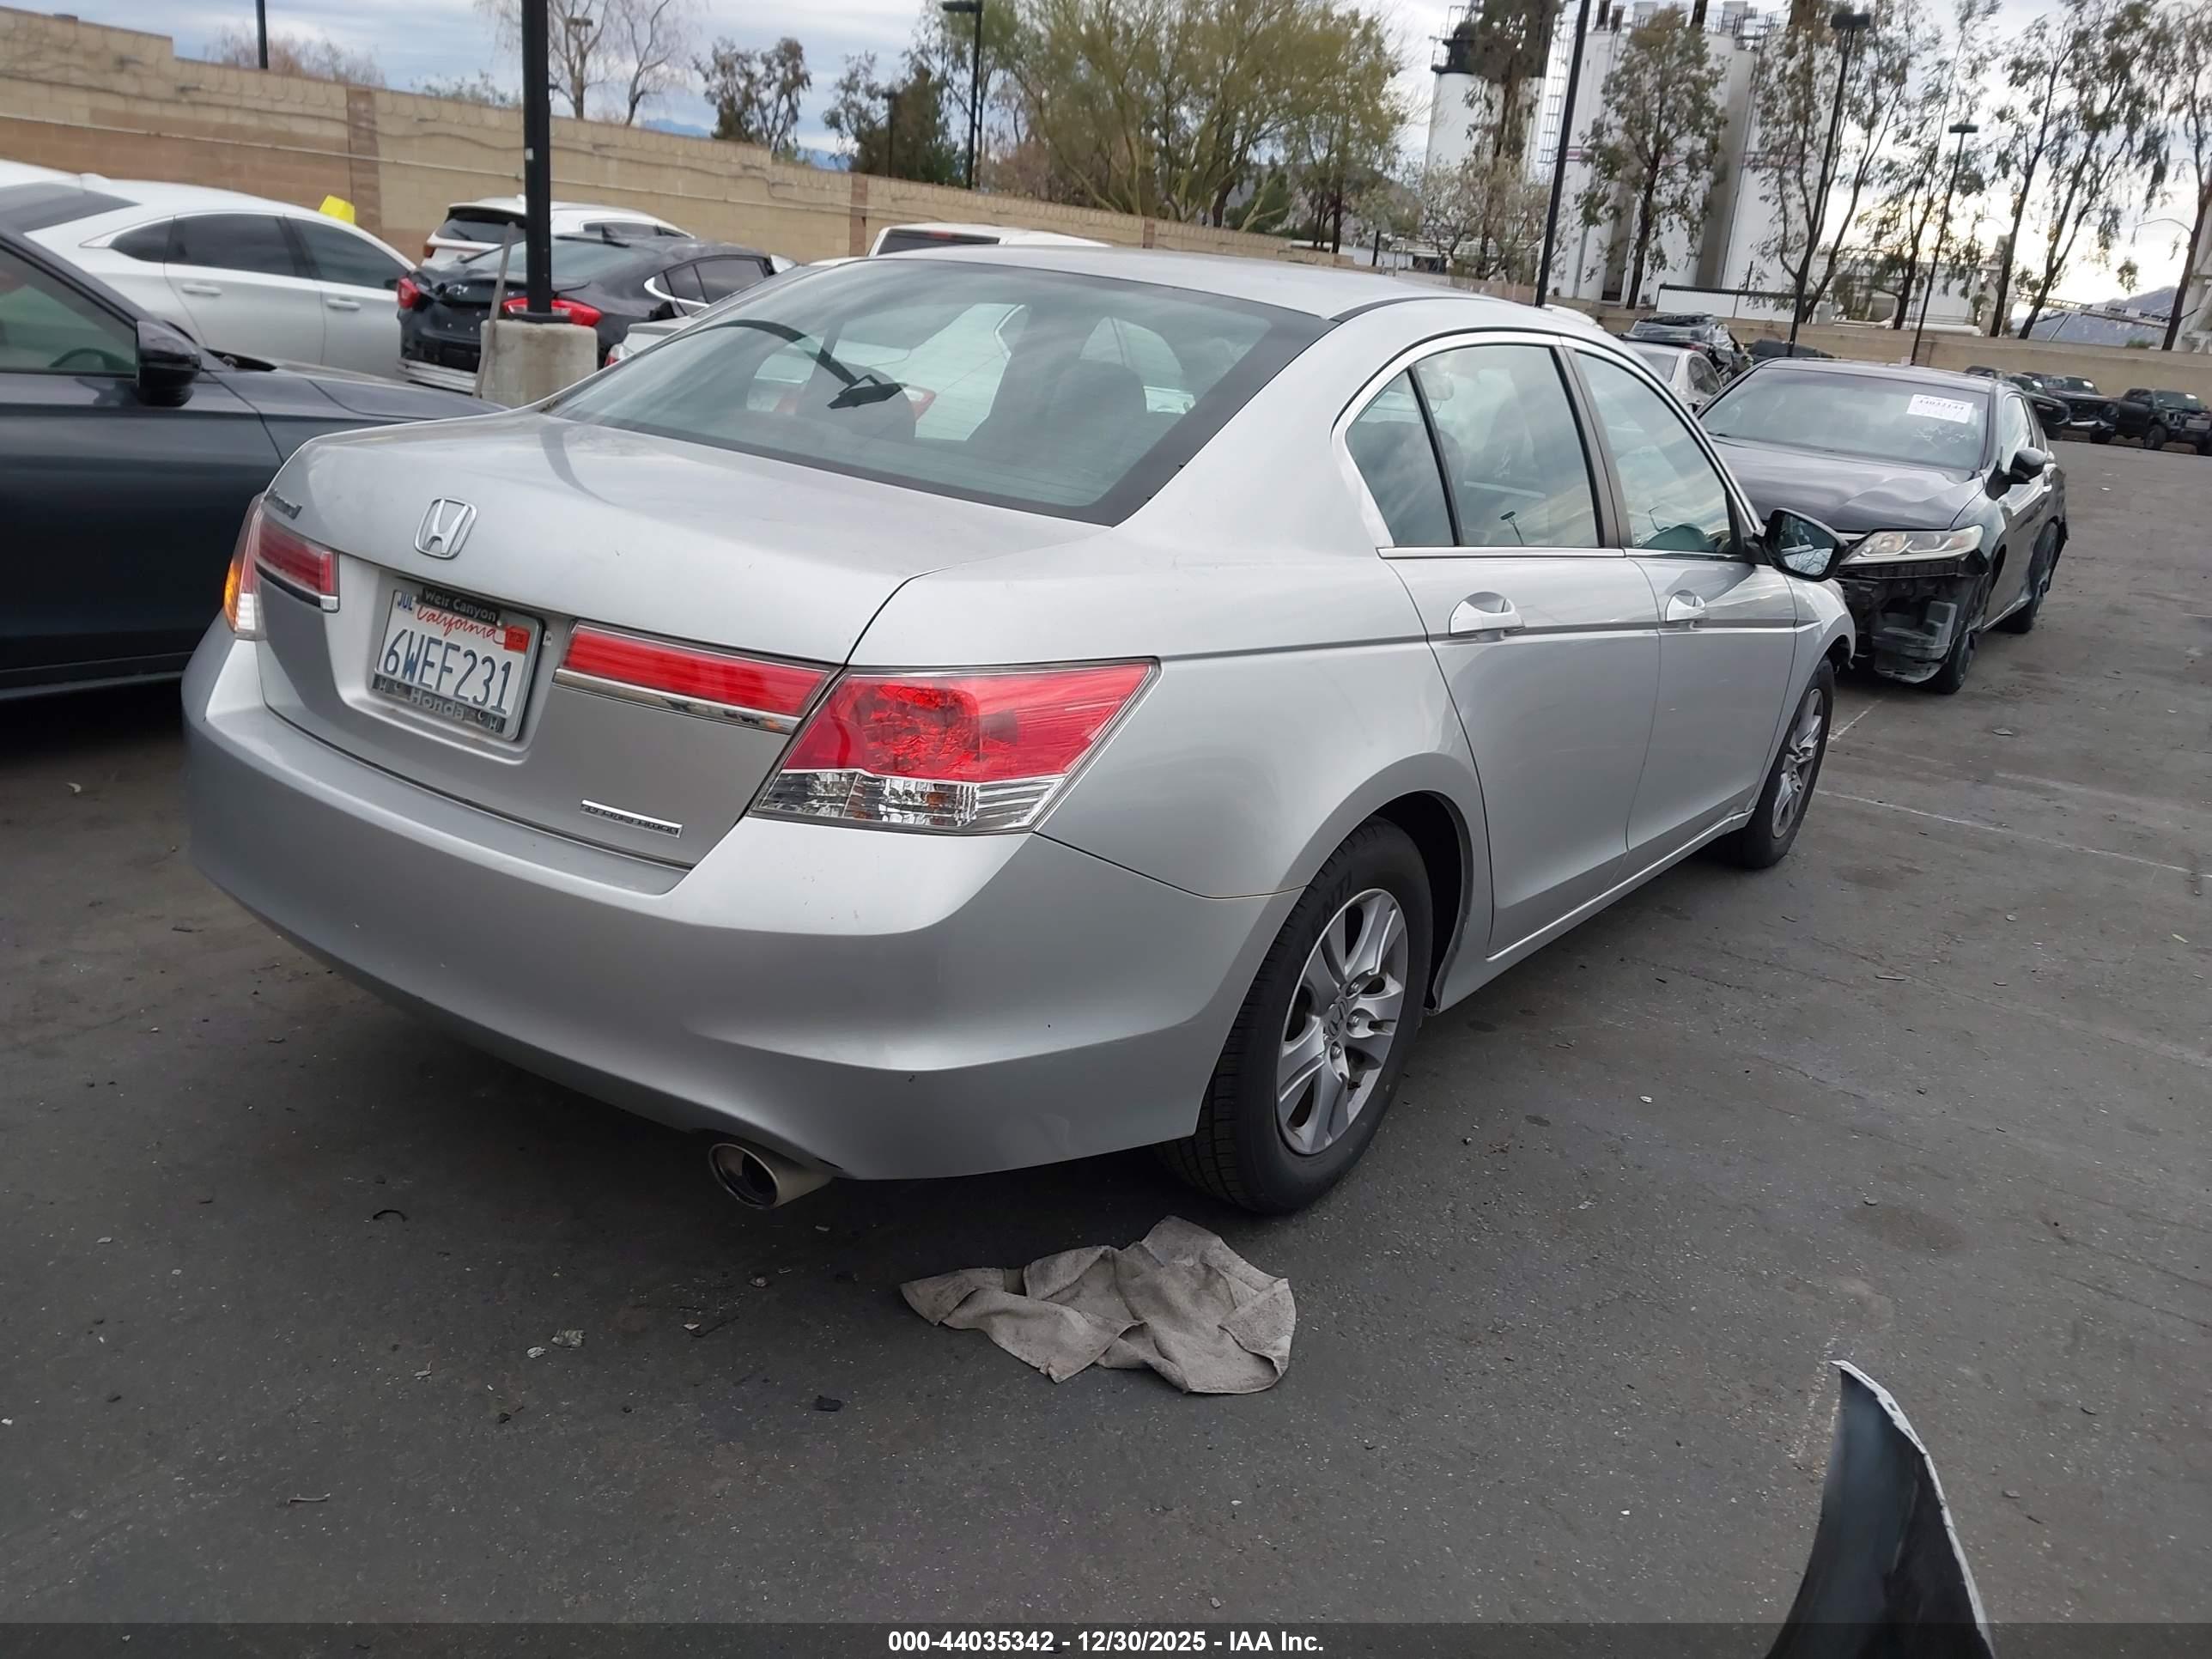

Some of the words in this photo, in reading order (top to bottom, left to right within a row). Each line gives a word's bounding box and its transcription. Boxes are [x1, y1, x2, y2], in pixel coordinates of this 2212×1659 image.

[425, 590, 450, 608] Weir
[453, 599, 496, 623] Canyon
[416, 605, 505, 645] California
[383, 629, 512, 715] 6WEF231
[410, 688, 465, 720] Honda
